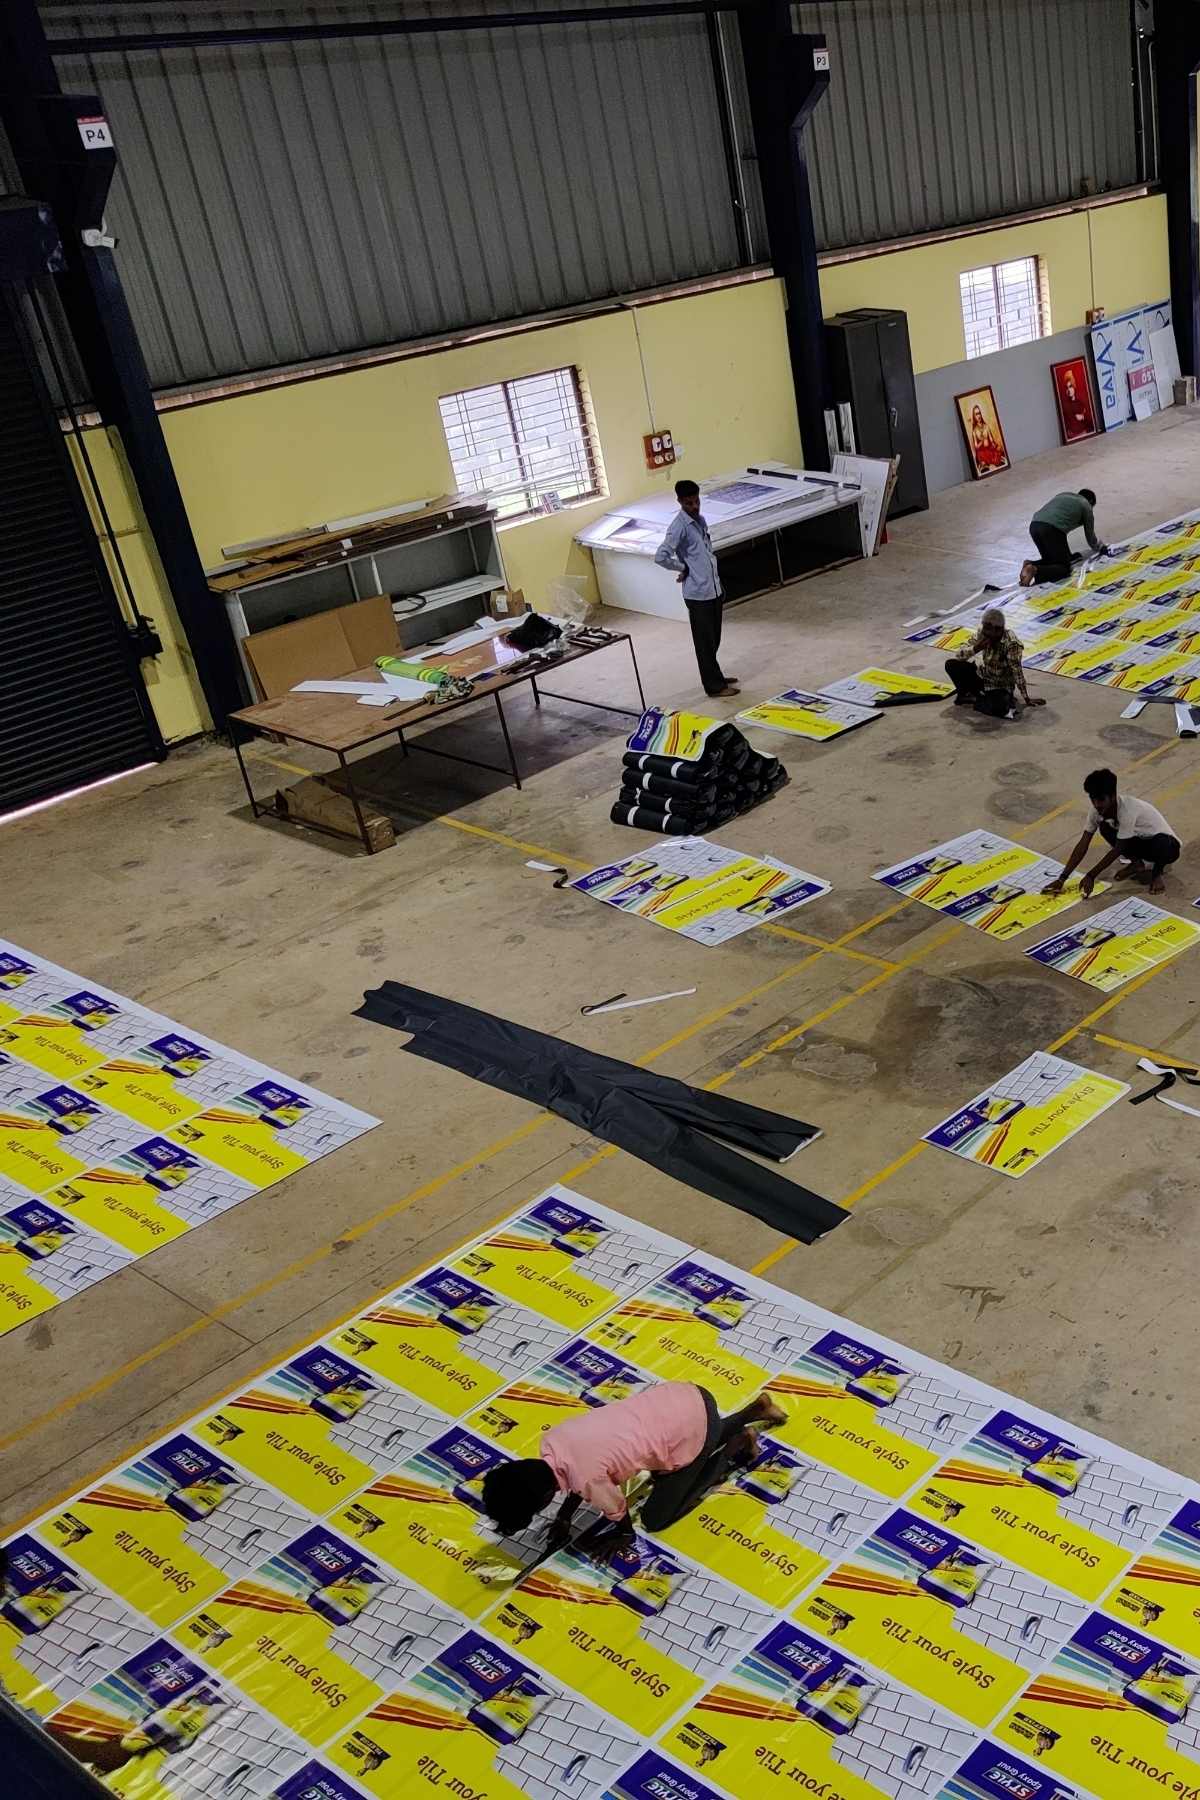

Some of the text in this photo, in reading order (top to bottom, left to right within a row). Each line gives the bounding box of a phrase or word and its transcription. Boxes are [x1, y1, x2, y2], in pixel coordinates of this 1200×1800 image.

[816, 57, 826, 66] P3
[85, 129, 106, 143] P4
[545, 1209, 574, 1225] STYLE
[433, 1281, 464, 1298] STYLE
[514, 1263, 594, 1307] Style your Tile
[684, 1275, 715, 1292] STYLE
[396, 1341, 477, 1391] Style your Tile
[657, 1335, 744, 1385] Style your Tile
[831, 1346, 865, 1365] STYLE
[309, 1362, 340, 1381] STYLE
[811, 1414, 910, 1470] Style your Tile
[1002, 1428, 1040, 1449] STYLE
[169, 1452, 201, 1473] STYLE
[264, 1430, 346, 1486] Style your Tile
[448, 1444, 481, 1465] STYLE
[406, 1521, 469, 1562] your Tile
[696, 1512, 798, 1577] Style your Tile
[899, 1529, 938, 1553] STYLE
[989, 1504, 1101, 1568] Style your Tile
[113, 1529, 196, 1594] Style your Tile
[307, 1546, 342, 1570] STYLE
[566, 1625, 670, 1699] Style your Tile
[780, 1645, 821, 1672] STYLE
[880, 1616, 995, 1689] Style your Tile
[1099, 1636, 1143, 1663] STYLE
[145, 1662, 181, 1690] STYLE
[254, 1634, 348, 1708] Style your Tile
[461, 1654, 500, 1681] STYLE
[414, 1755, 446, 1787] Tile
[752, 1746, 831, 1800] your Tile
[1091, 1736, 1177, 1790] your Tile
[987, 1769, 1033, 1800] STYLE
